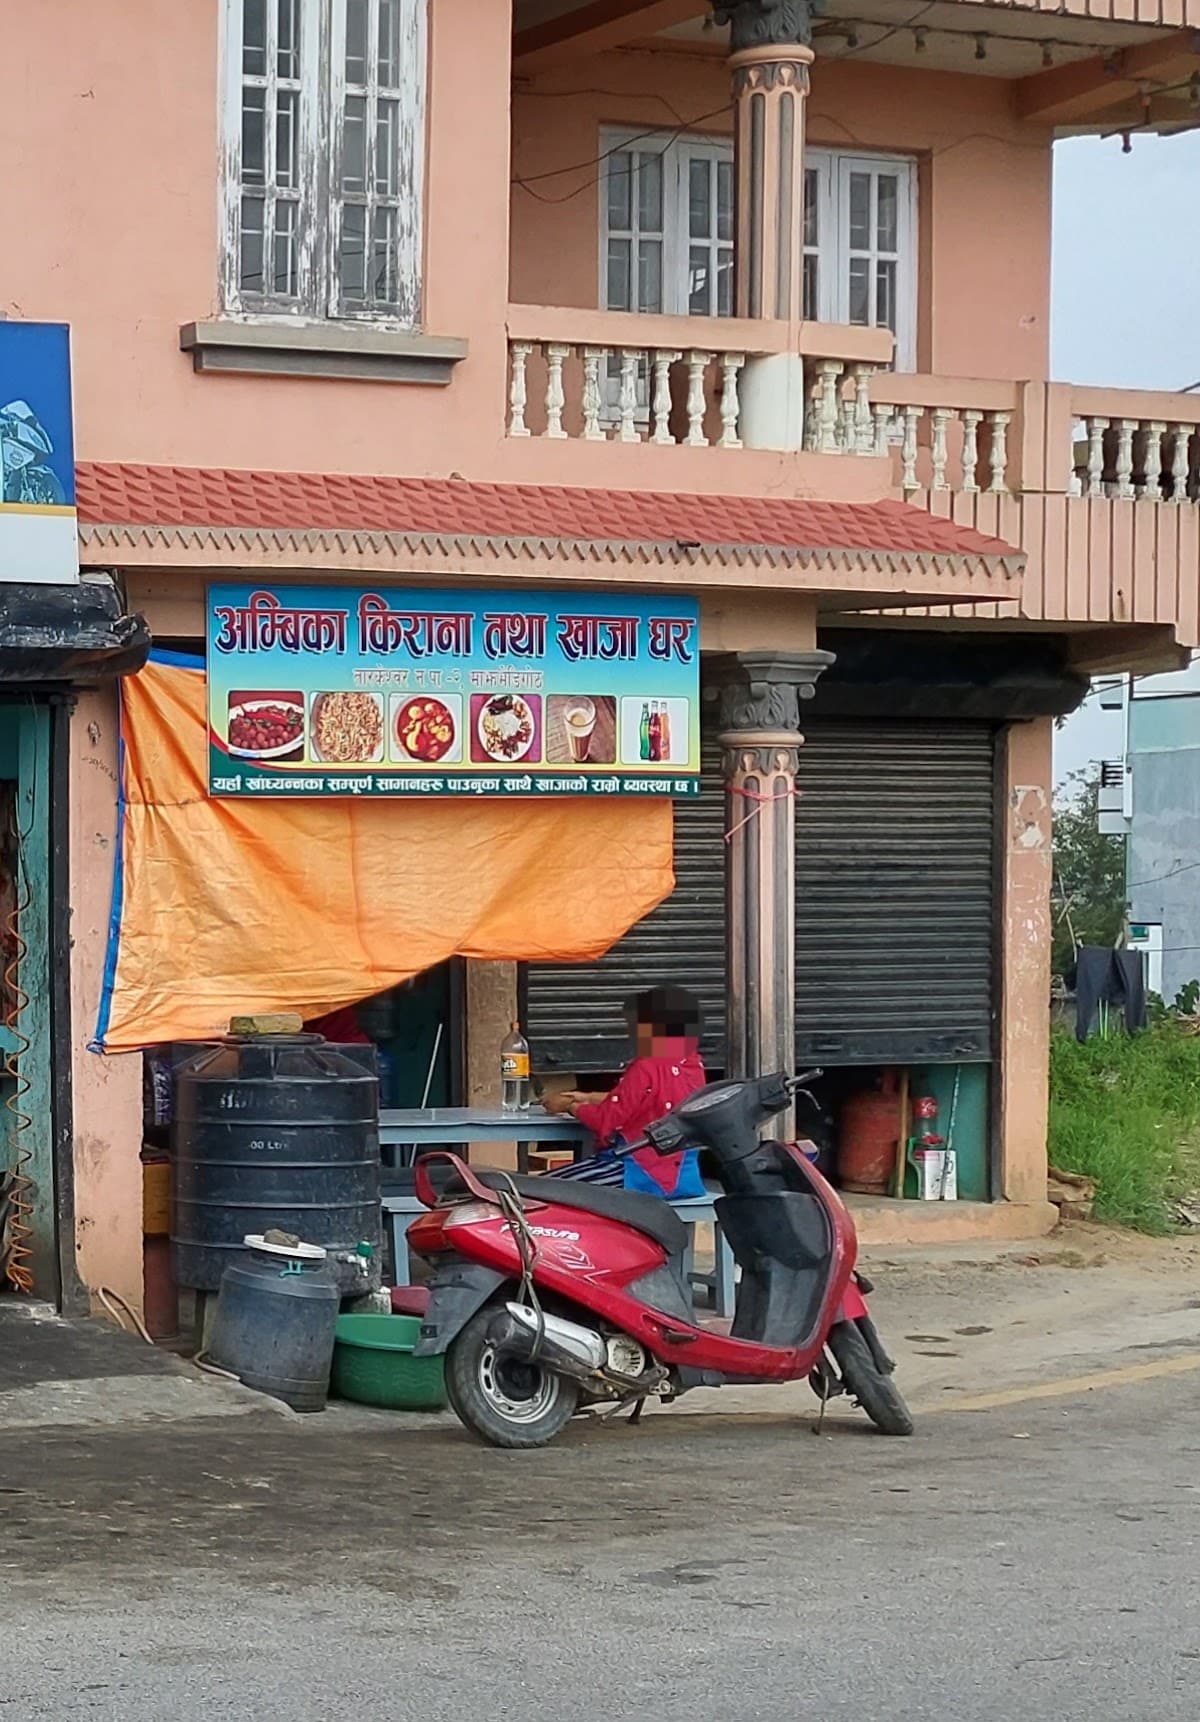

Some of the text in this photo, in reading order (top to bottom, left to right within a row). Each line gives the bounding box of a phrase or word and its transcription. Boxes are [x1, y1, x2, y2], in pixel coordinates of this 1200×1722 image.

[215, 591, 698, 664] अम्बिका किराना तथा खाजा घर
[327, 775, 372, 793] सम्पूर्ण
[447, 778, 499, 793] पाउनुका
[535, 775, 587, 791] खाजाको
[591, 775, 620, 793] राम्रो
[674, 780, 690, 792] छ
